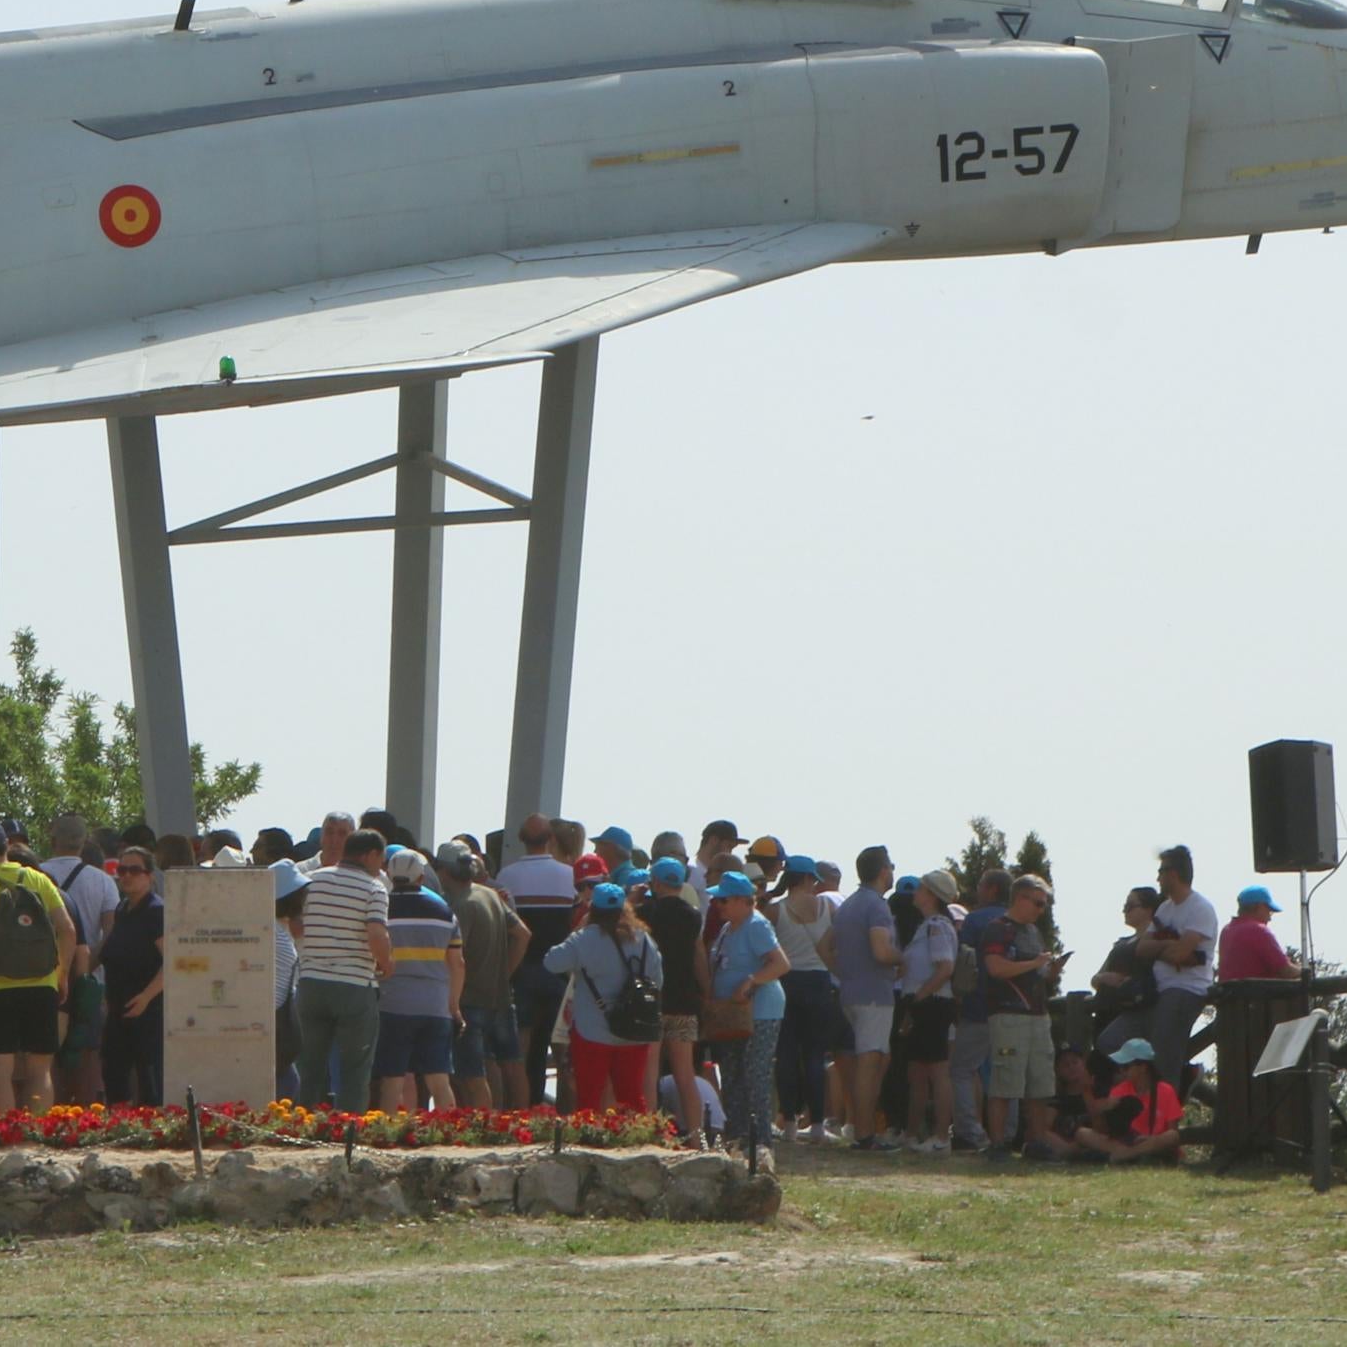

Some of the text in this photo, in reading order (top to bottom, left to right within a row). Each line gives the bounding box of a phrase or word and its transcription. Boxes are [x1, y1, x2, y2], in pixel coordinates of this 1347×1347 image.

[262, 67, 277, 86] 2
[723, 80, 737, 97] 2
[936, 123, 1080, 183] 12-57
